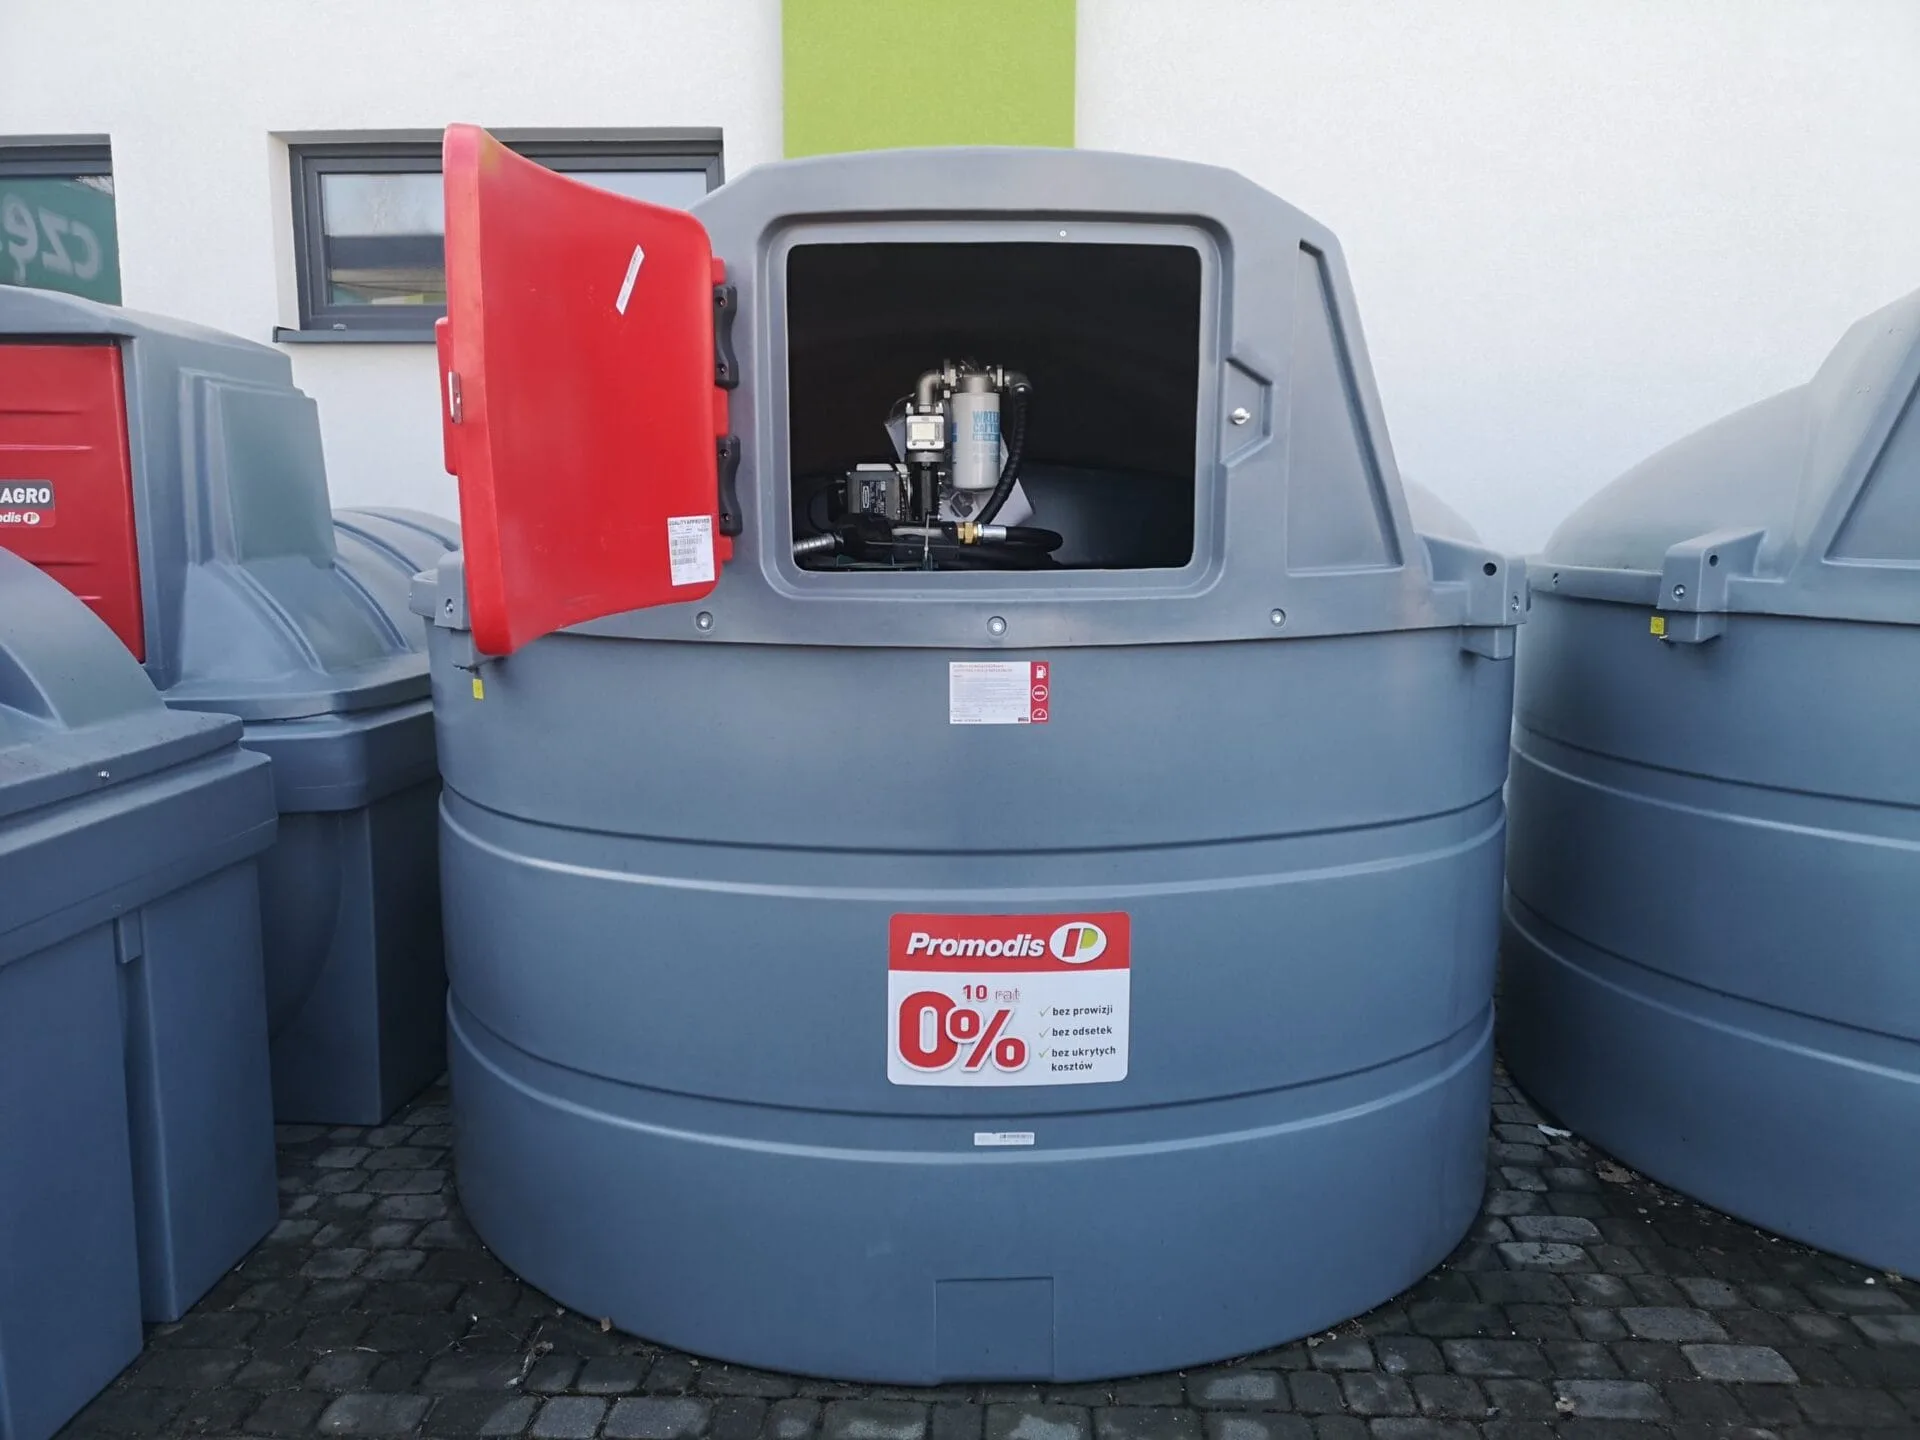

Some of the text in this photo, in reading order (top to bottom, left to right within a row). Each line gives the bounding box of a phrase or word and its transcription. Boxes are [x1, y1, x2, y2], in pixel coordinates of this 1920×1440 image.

[0, 487, 51, 504] AGRO
[906, 932, 1045, 957] Promodis
[963, 984, 1020, 1001] 10 rat
[1052, 1004, 1113, 1018] bez prowizji
[897, 990, 1028, 1071] 0%
[1052, 1025, 1113, 1036] bez odsetek
[1051, 1046, 1116, 1057] bez ukrytych
[1051, 1060, 1093, 1072] kosztów
